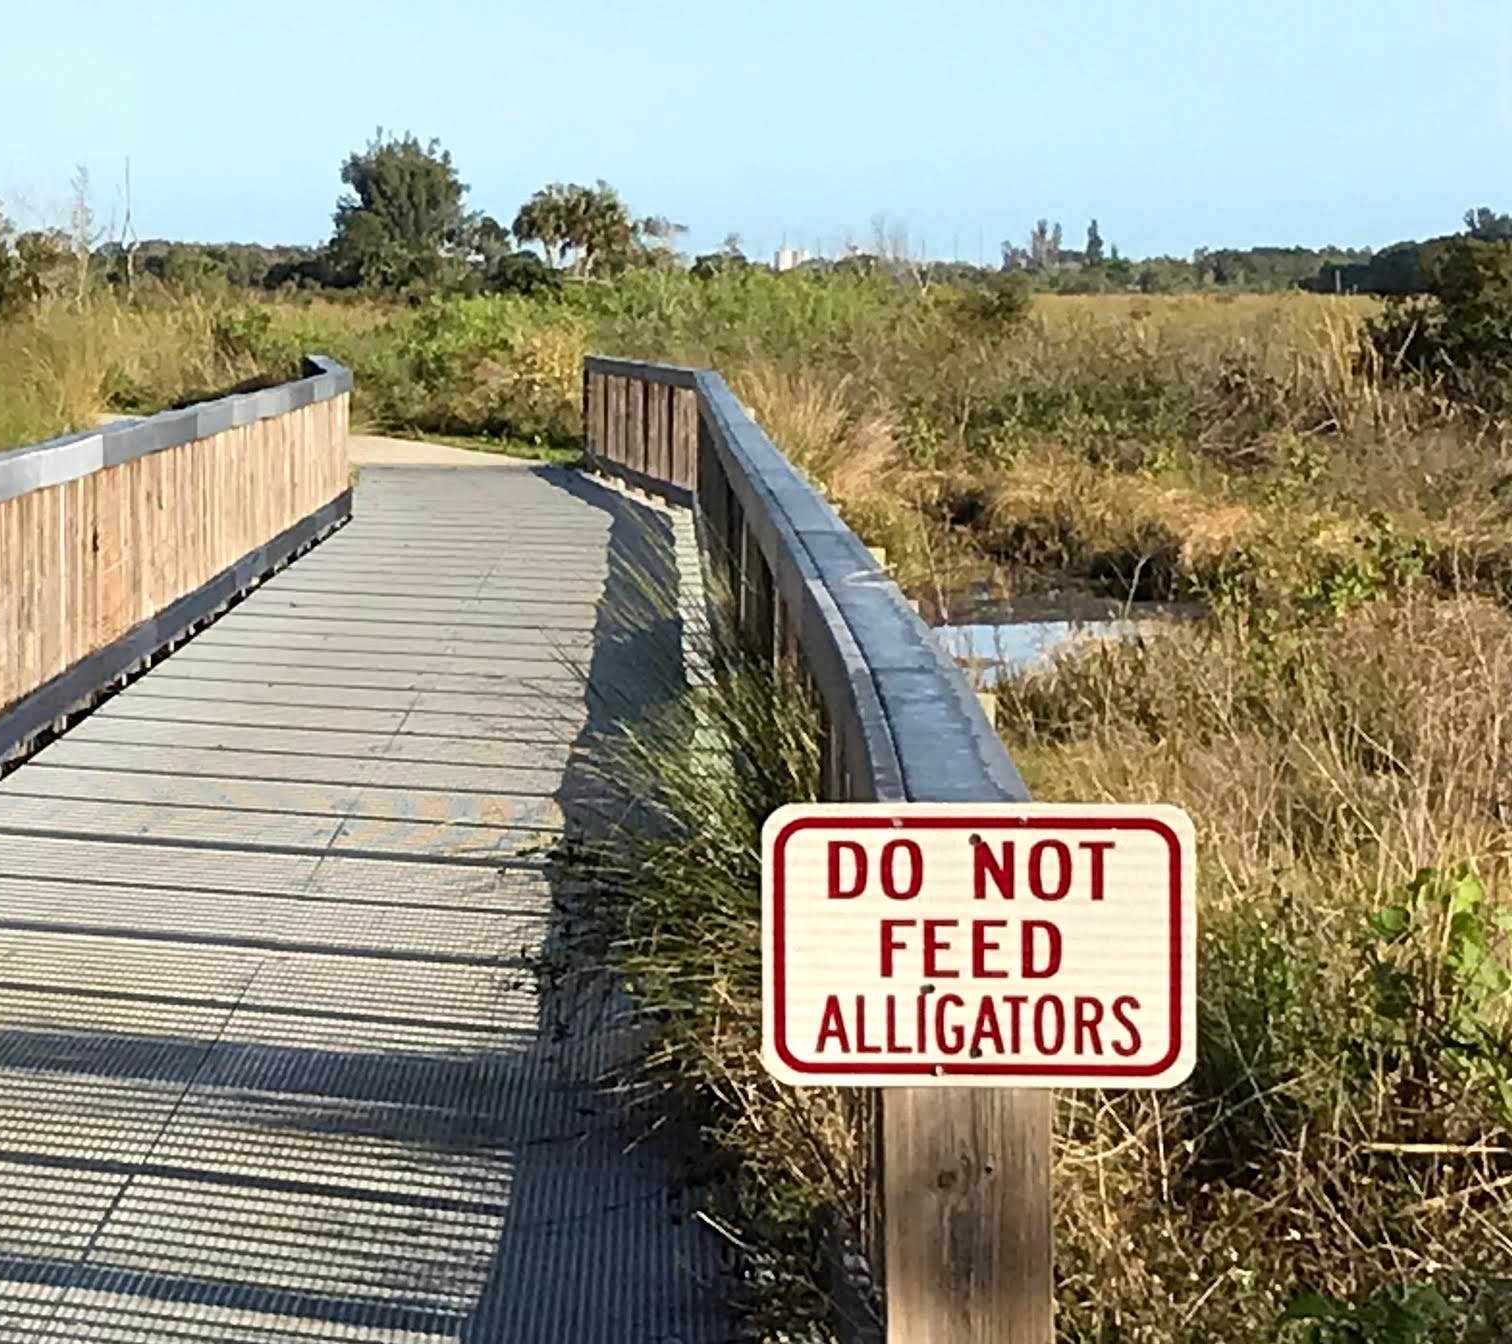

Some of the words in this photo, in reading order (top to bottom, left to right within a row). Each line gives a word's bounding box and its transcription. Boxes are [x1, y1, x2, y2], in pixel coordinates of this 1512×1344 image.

[828, 839, 923, 900] DO
[973, 839, 1116, 901] NOT
[880, 919, 1063, 979] FEED
[815, 993, 1143, 1056] ALLIGATORS
